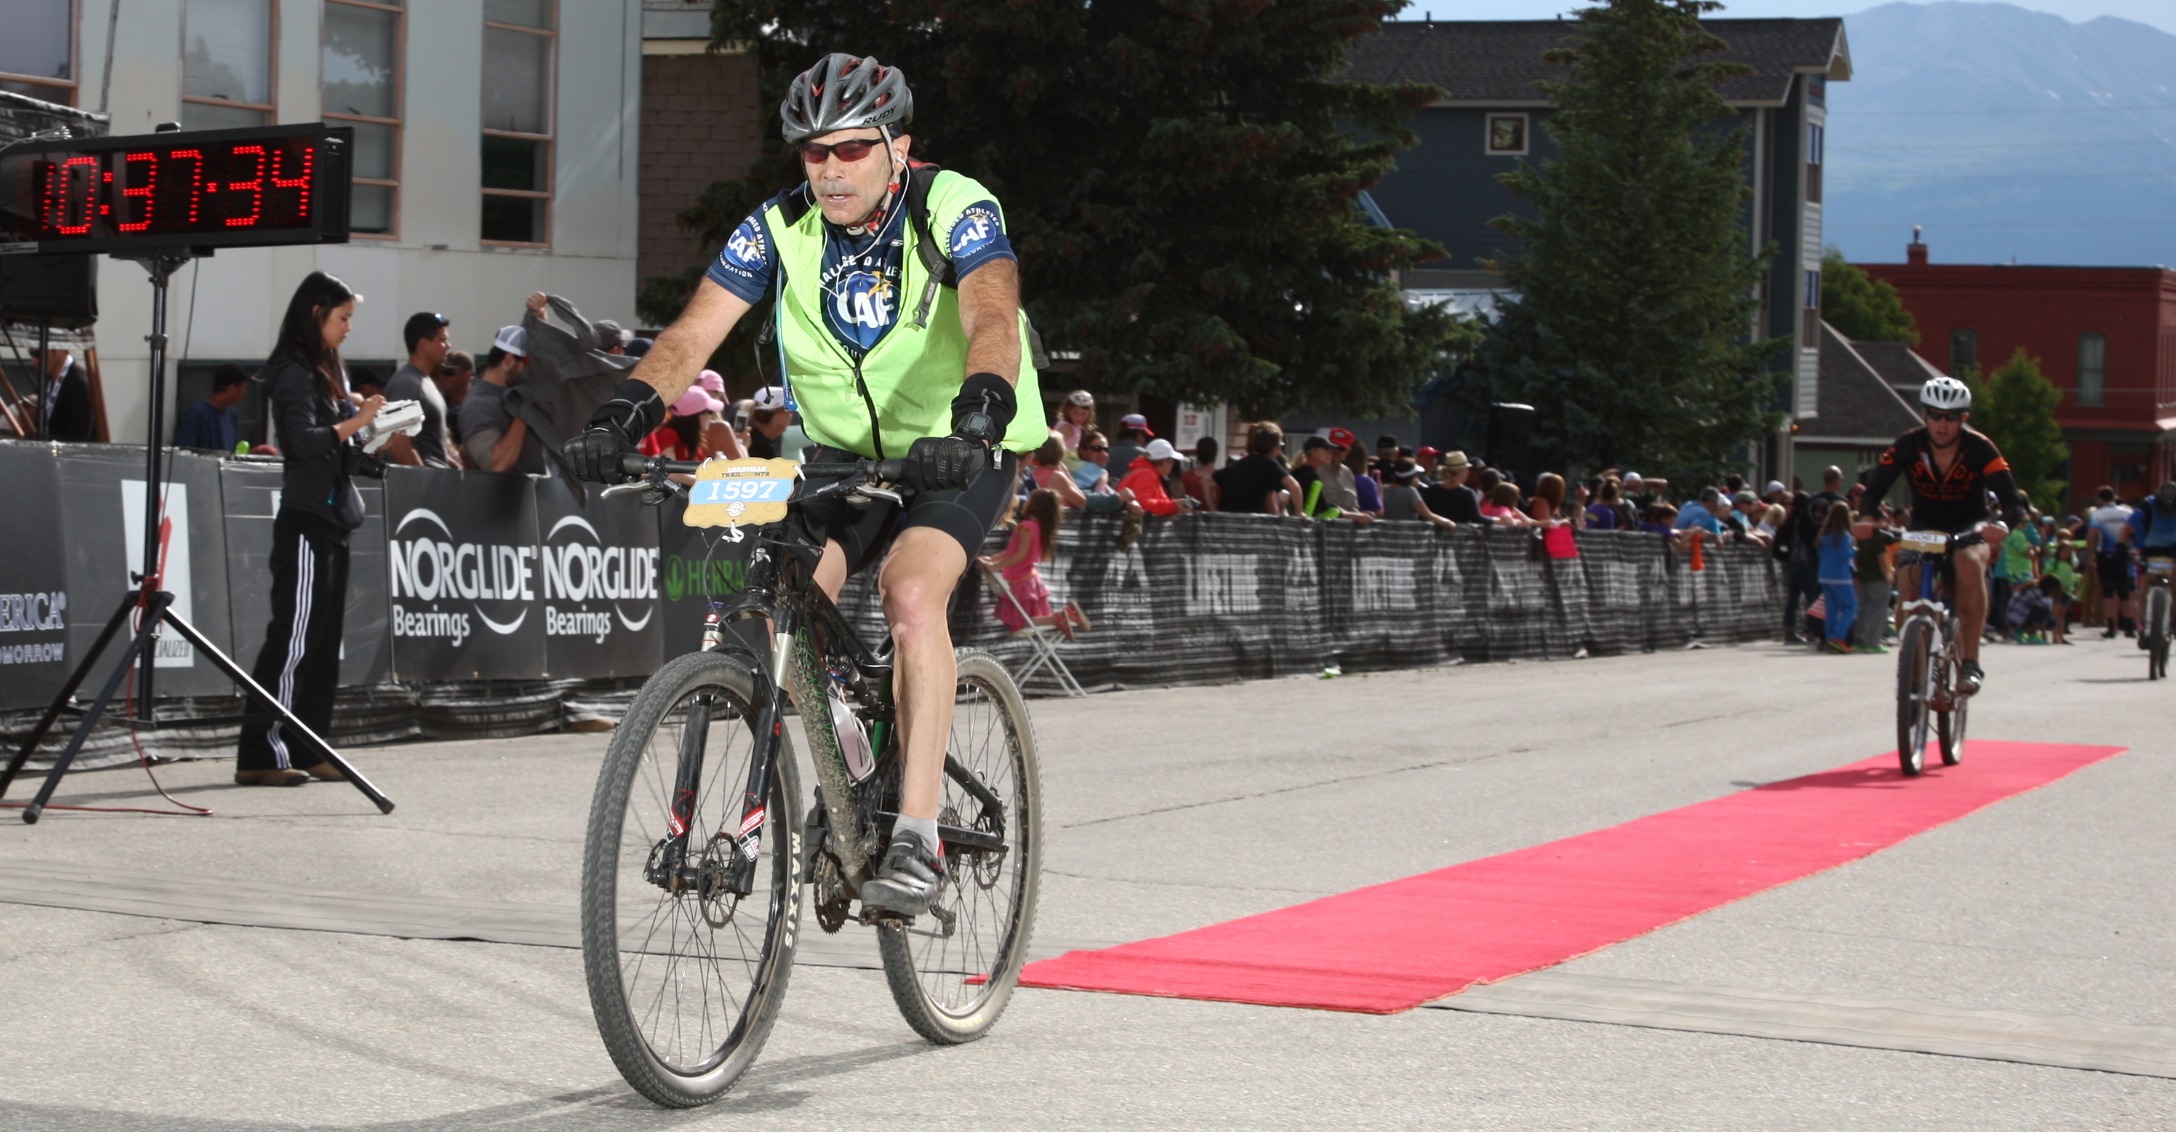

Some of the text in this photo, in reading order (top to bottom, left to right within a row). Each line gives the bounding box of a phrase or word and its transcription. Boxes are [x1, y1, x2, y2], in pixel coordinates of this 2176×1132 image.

[862, 106, 896, 125] RUDY
[727, 228, 761, 262] CAF
[836, 289, 895, 329] CAF
[707, 481, 778, 501] 1597
[390, 537, 535, 601] NORGLIDE
[541, 541, 658, 602] NORGLIDE
[687, 560, 745, 596] HERBA
[0, 591, 65, 632] ERICA
[392, 604, 471, 647] Bearings
[545, 604, 612, 644] Bearings
[0, 643, 65, 665] MORROW
[784, 832, 801, 949] MAXXIS
